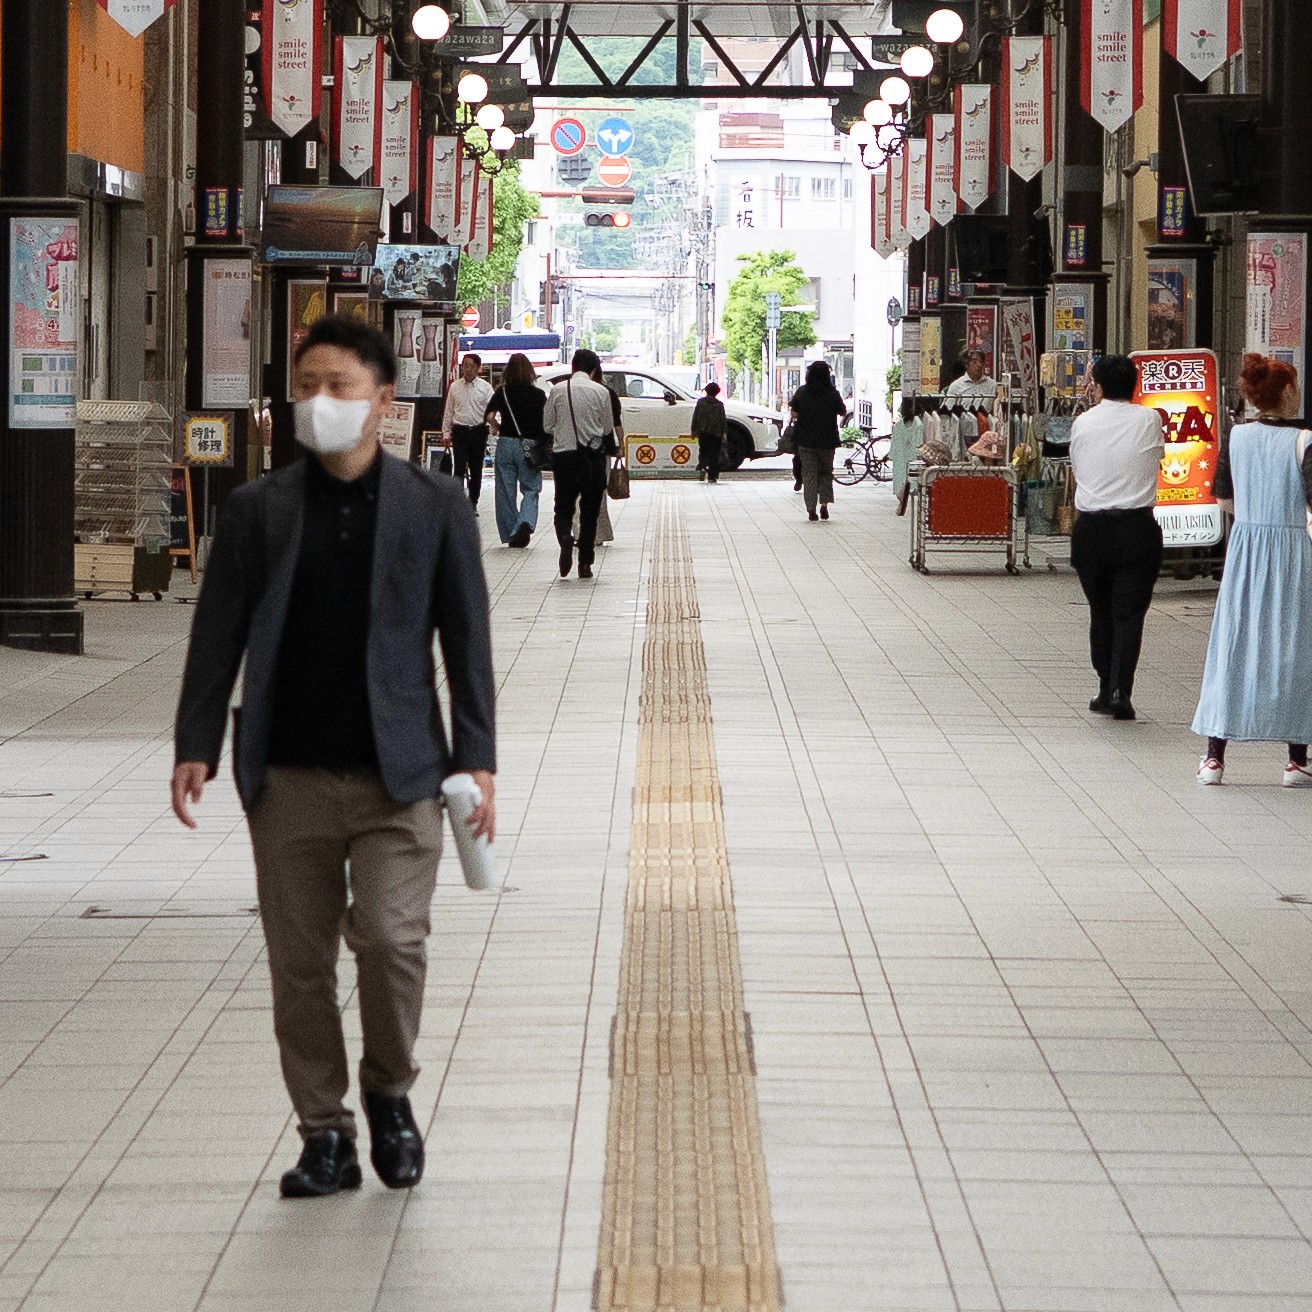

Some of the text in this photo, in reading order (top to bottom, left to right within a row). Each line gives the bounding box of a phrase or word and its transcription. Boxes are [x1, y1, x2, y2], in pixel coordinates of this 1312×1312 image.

[1097, 31, 1127, 42] smile
[278, 39, 307, 49] smile
[1097, 42, 1127, 53] smile
[278, 49, 307, 60] smile
[1097, 54, 1127, 63] street
[278, 60, 307, 70] street
[345, 98, 370, 107] smile
[1015, 100, 1039, 109] smile
[345, 106, 370, 115] smile
[1015, 108, 1039, 117] smile
[345, 115, 370, 124] street
[1015, 117, 1039, 126] street
[1143, 382, 1205, 393] ICHIBA
[191, 426, 217, 440] 時計
[197, 439, 222, 453] 修理
[1163, 532, 1216, 542] ード・アイシン
